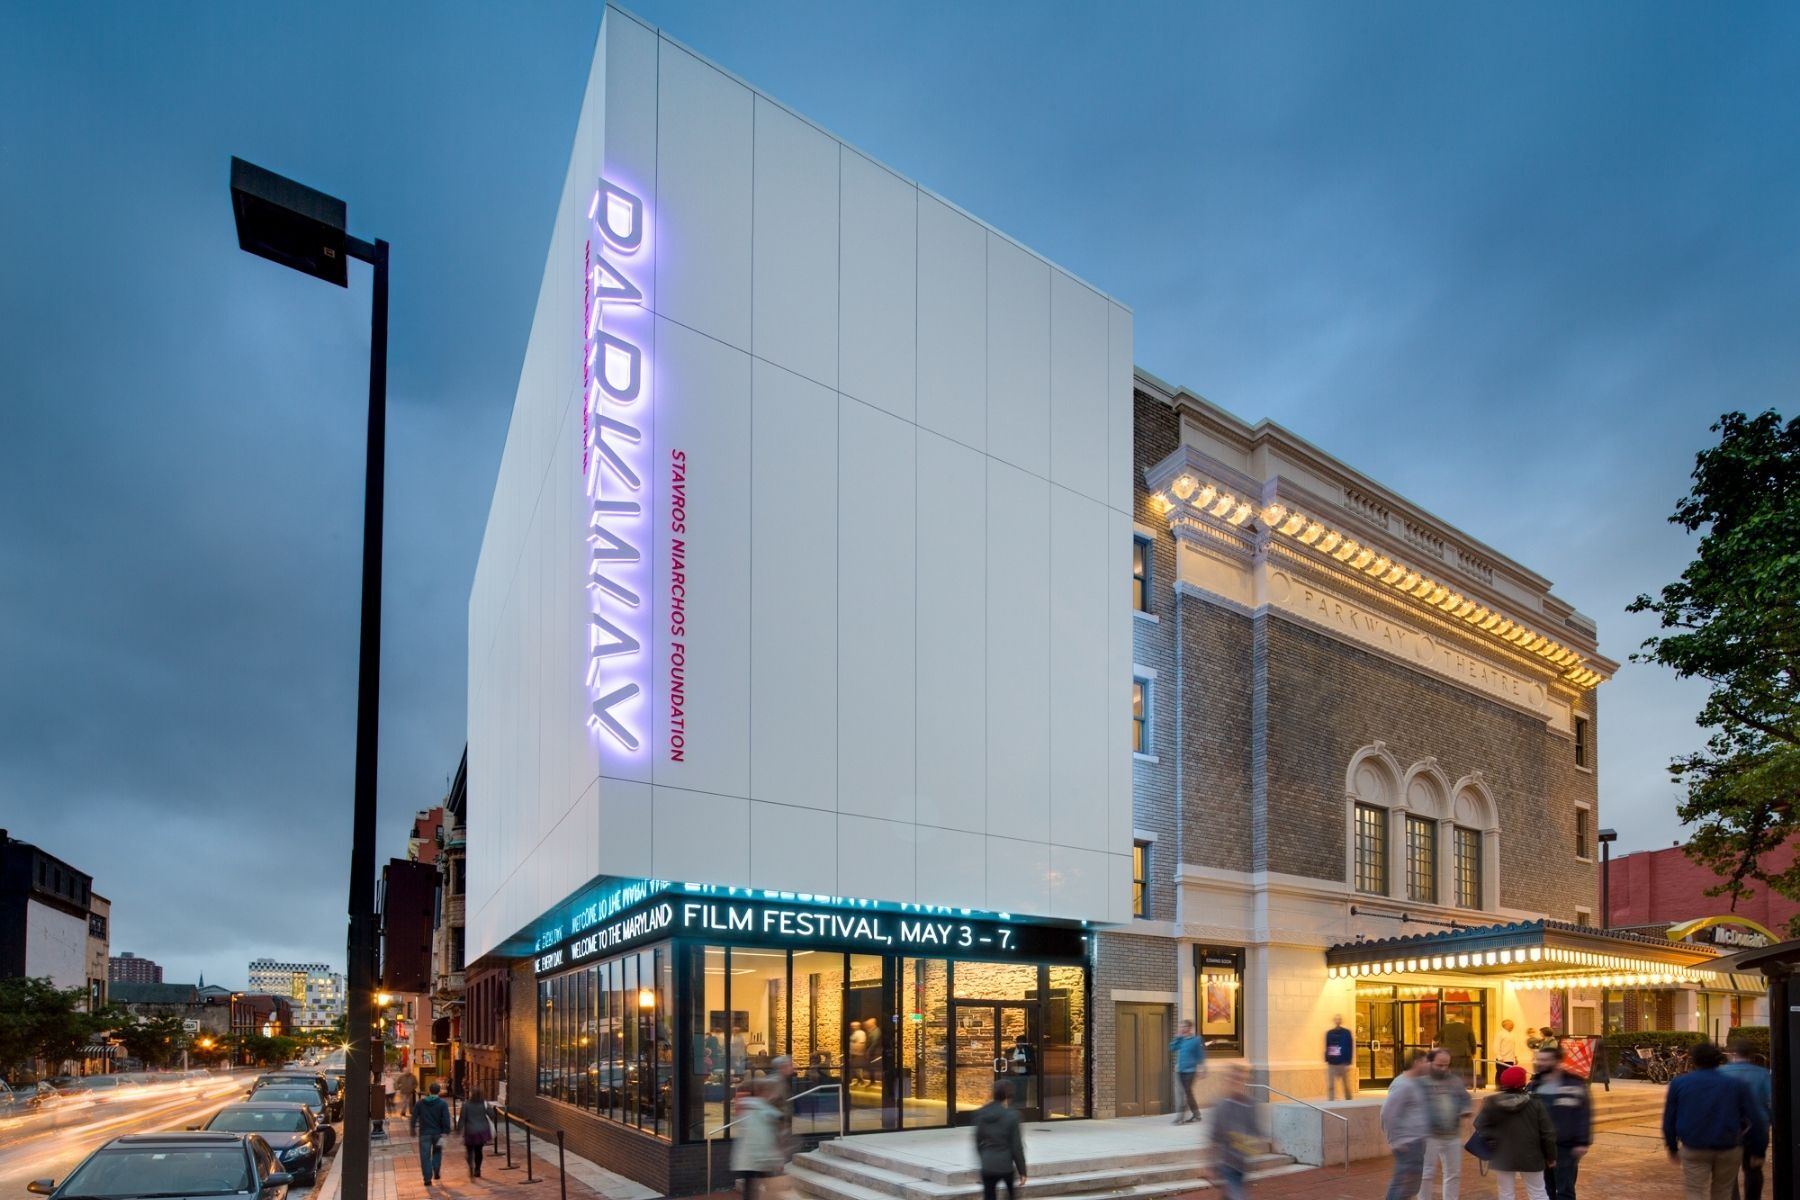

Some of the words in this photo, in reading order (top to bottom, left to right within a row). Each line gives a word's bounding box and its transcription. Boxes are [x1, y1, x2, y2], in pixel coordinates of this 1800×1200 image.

[587, 177, 642, 753] PARKWAY
[671, 448, 686, 534] STAVROS
[671, 538, 686, 638] NIARCHOS
[1304, 590, 1408, 645] PARKWAY
[1442, 650, 1521, 697] THEATRE
[670, 642, 685, 763] FOUNDATION
[570, 933, 599, 961] WELCOME
[598, 929, 608, 950] TO
[608, 923, 622, 947] THE
[622, 902, 673, 941] MARYLAND
[683, 903, 754, 932] FILM
[762, 910, 893, 945] FESTIVAL,
[900, 920, 953, 945] MAY
[958, 925, 973, 947] 3
[998, 929, 1016, 950] 7.
